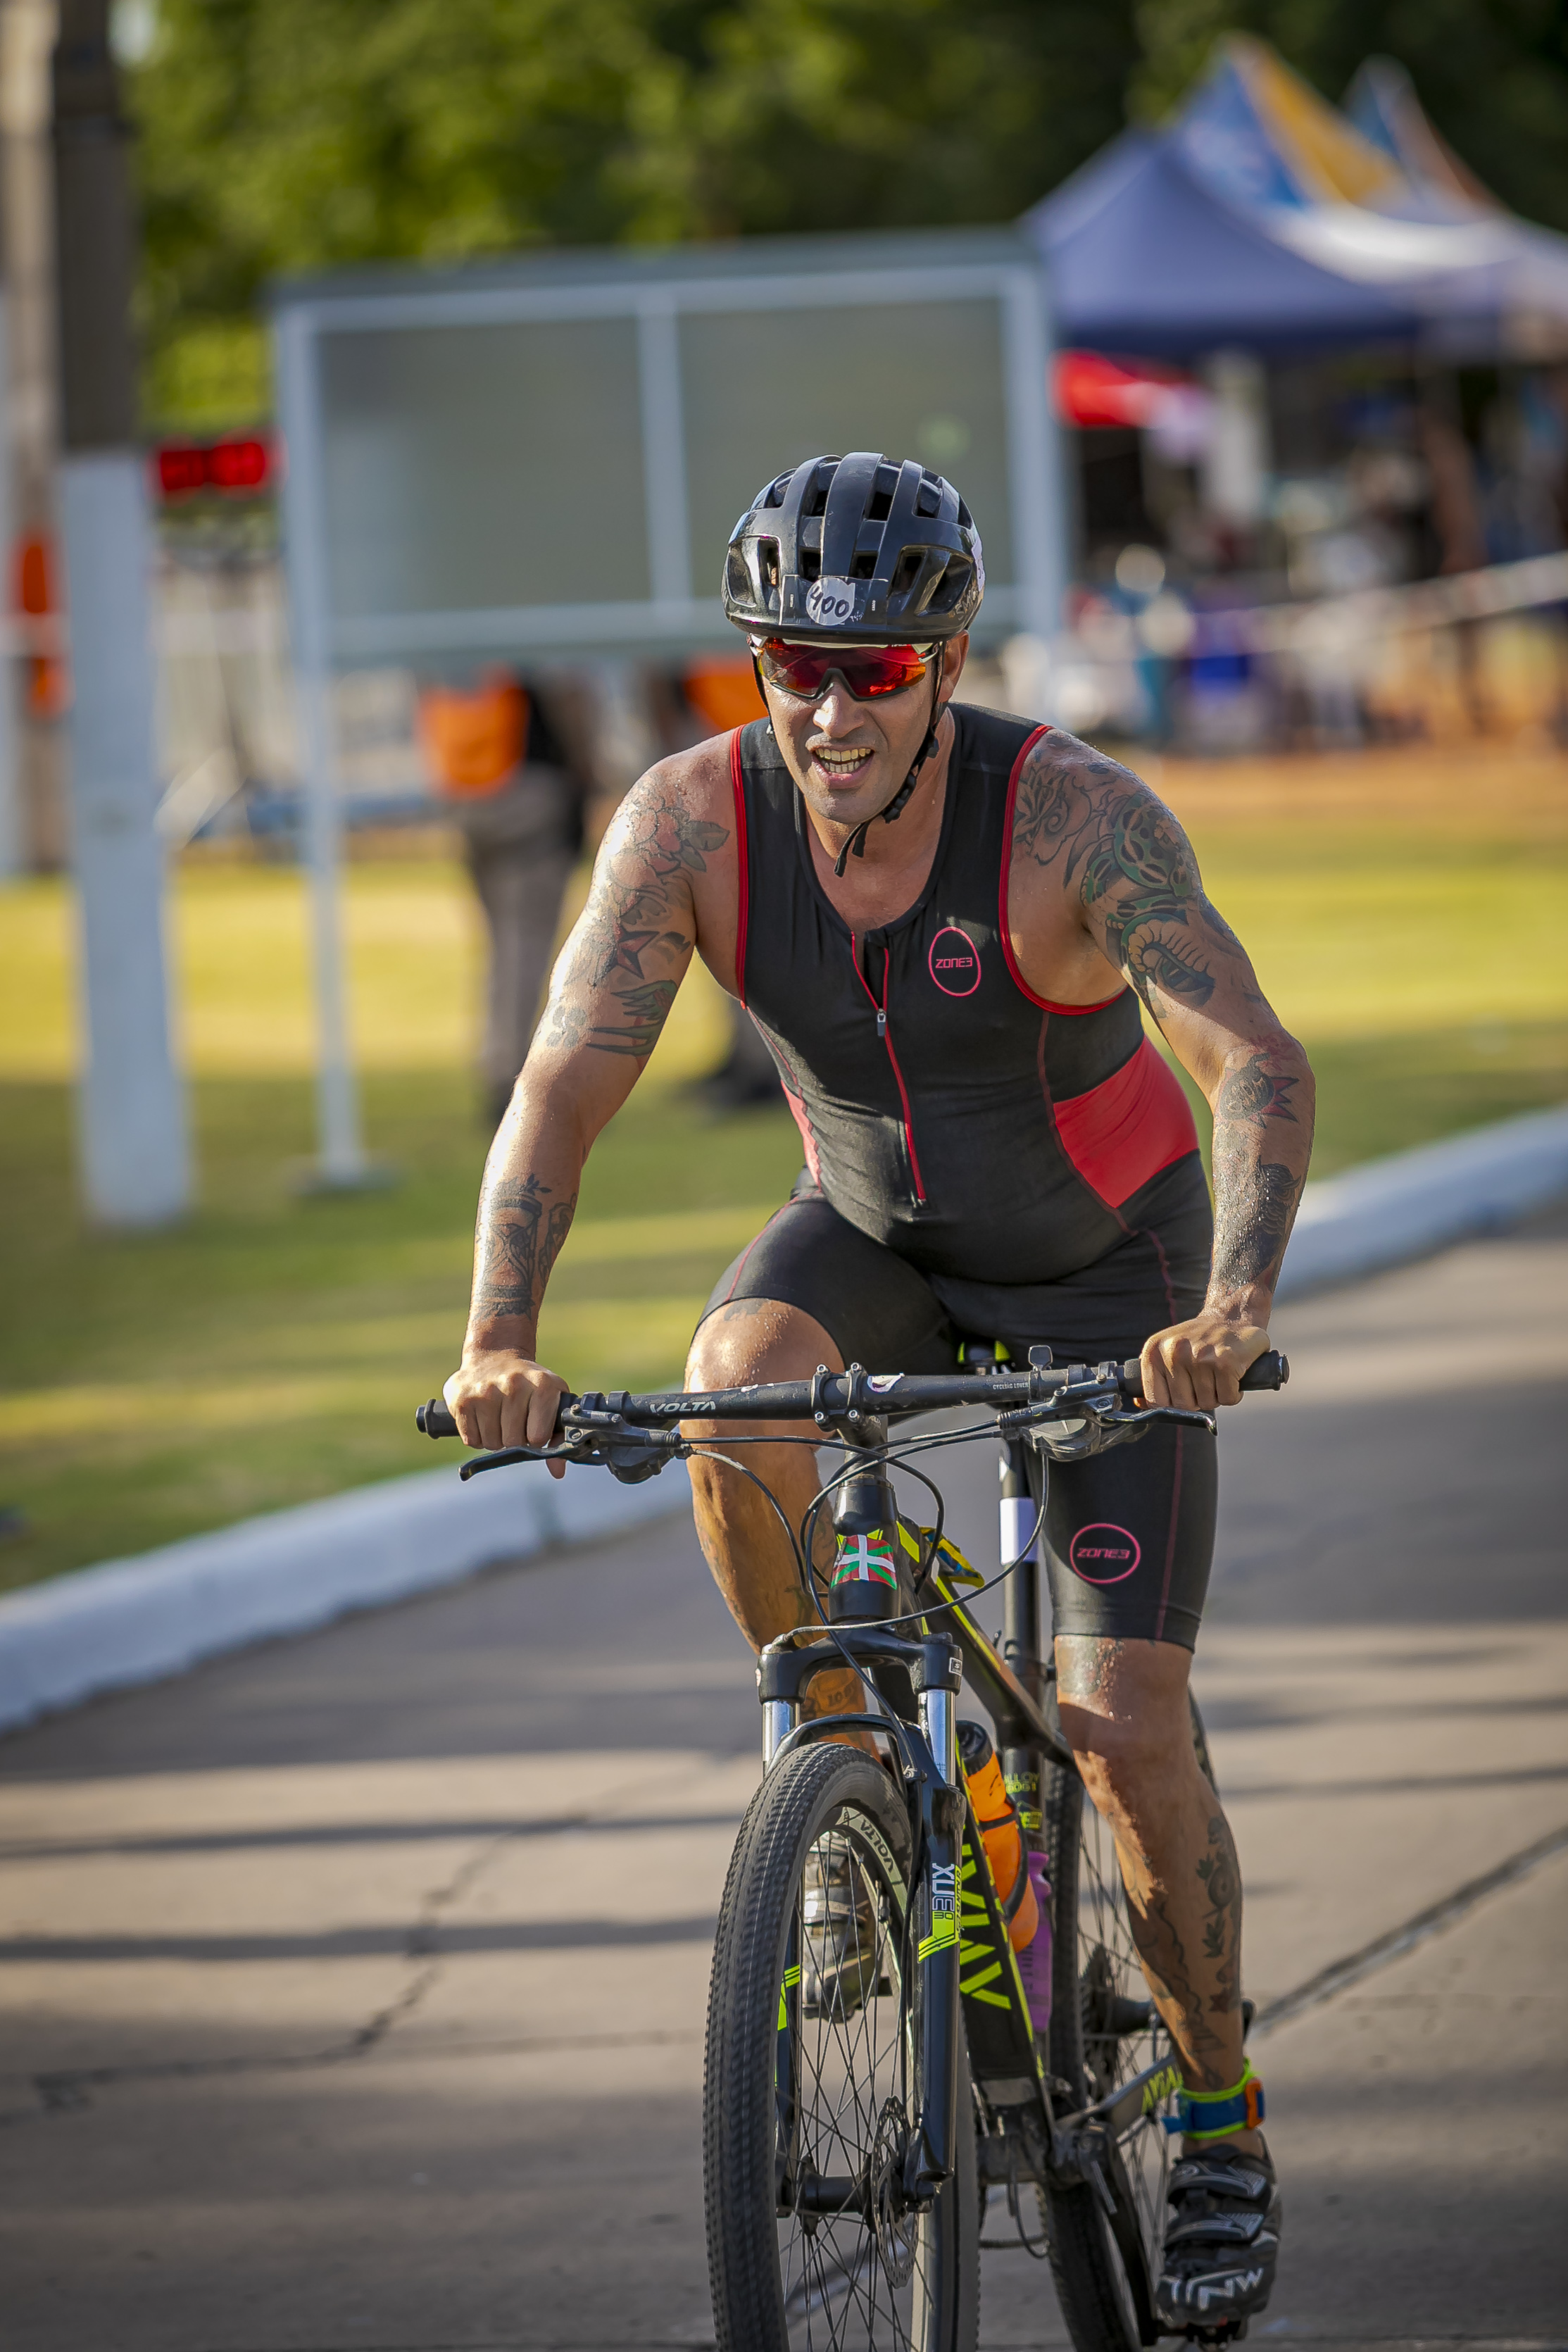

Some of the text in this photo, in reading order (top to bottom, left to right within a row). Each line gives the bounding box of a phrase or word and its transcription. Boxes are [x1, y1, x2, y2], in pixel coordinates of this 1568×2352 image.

[810, 586, 850, 618] 400
[935, 957, 973, 968] ZONE3
[649, 1401, 717, 1413] VOLTA
[1077, 1547, 1131, 1560] ZONE3
